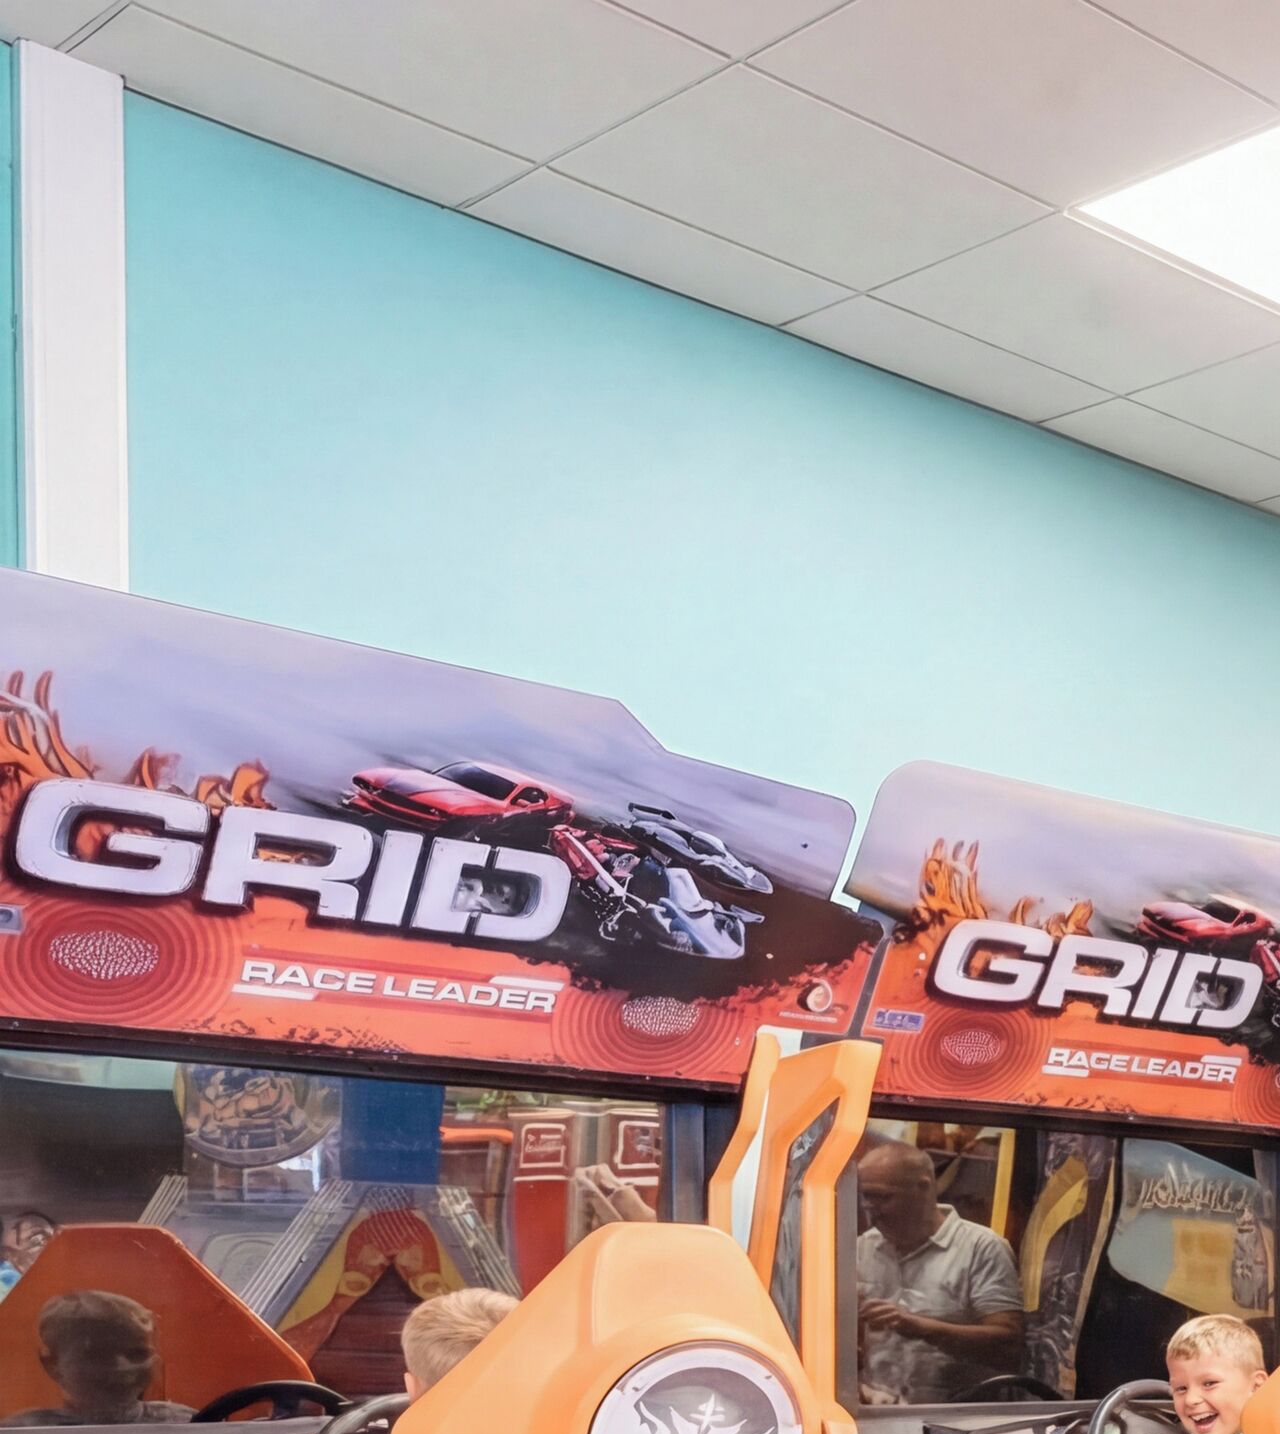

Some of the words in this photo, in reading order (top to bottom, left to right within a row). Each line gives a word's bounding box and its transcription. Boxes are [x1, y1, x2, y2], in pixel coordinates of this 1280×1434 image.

[15, 778, 572, 942] GRID
[240, 959, 377, 994] RACE
[382, 975, 557, 1013] LEADER
[933, 919, 1264, 1028] GRID
[1132, 1056, 1238, 1084] LEADER
